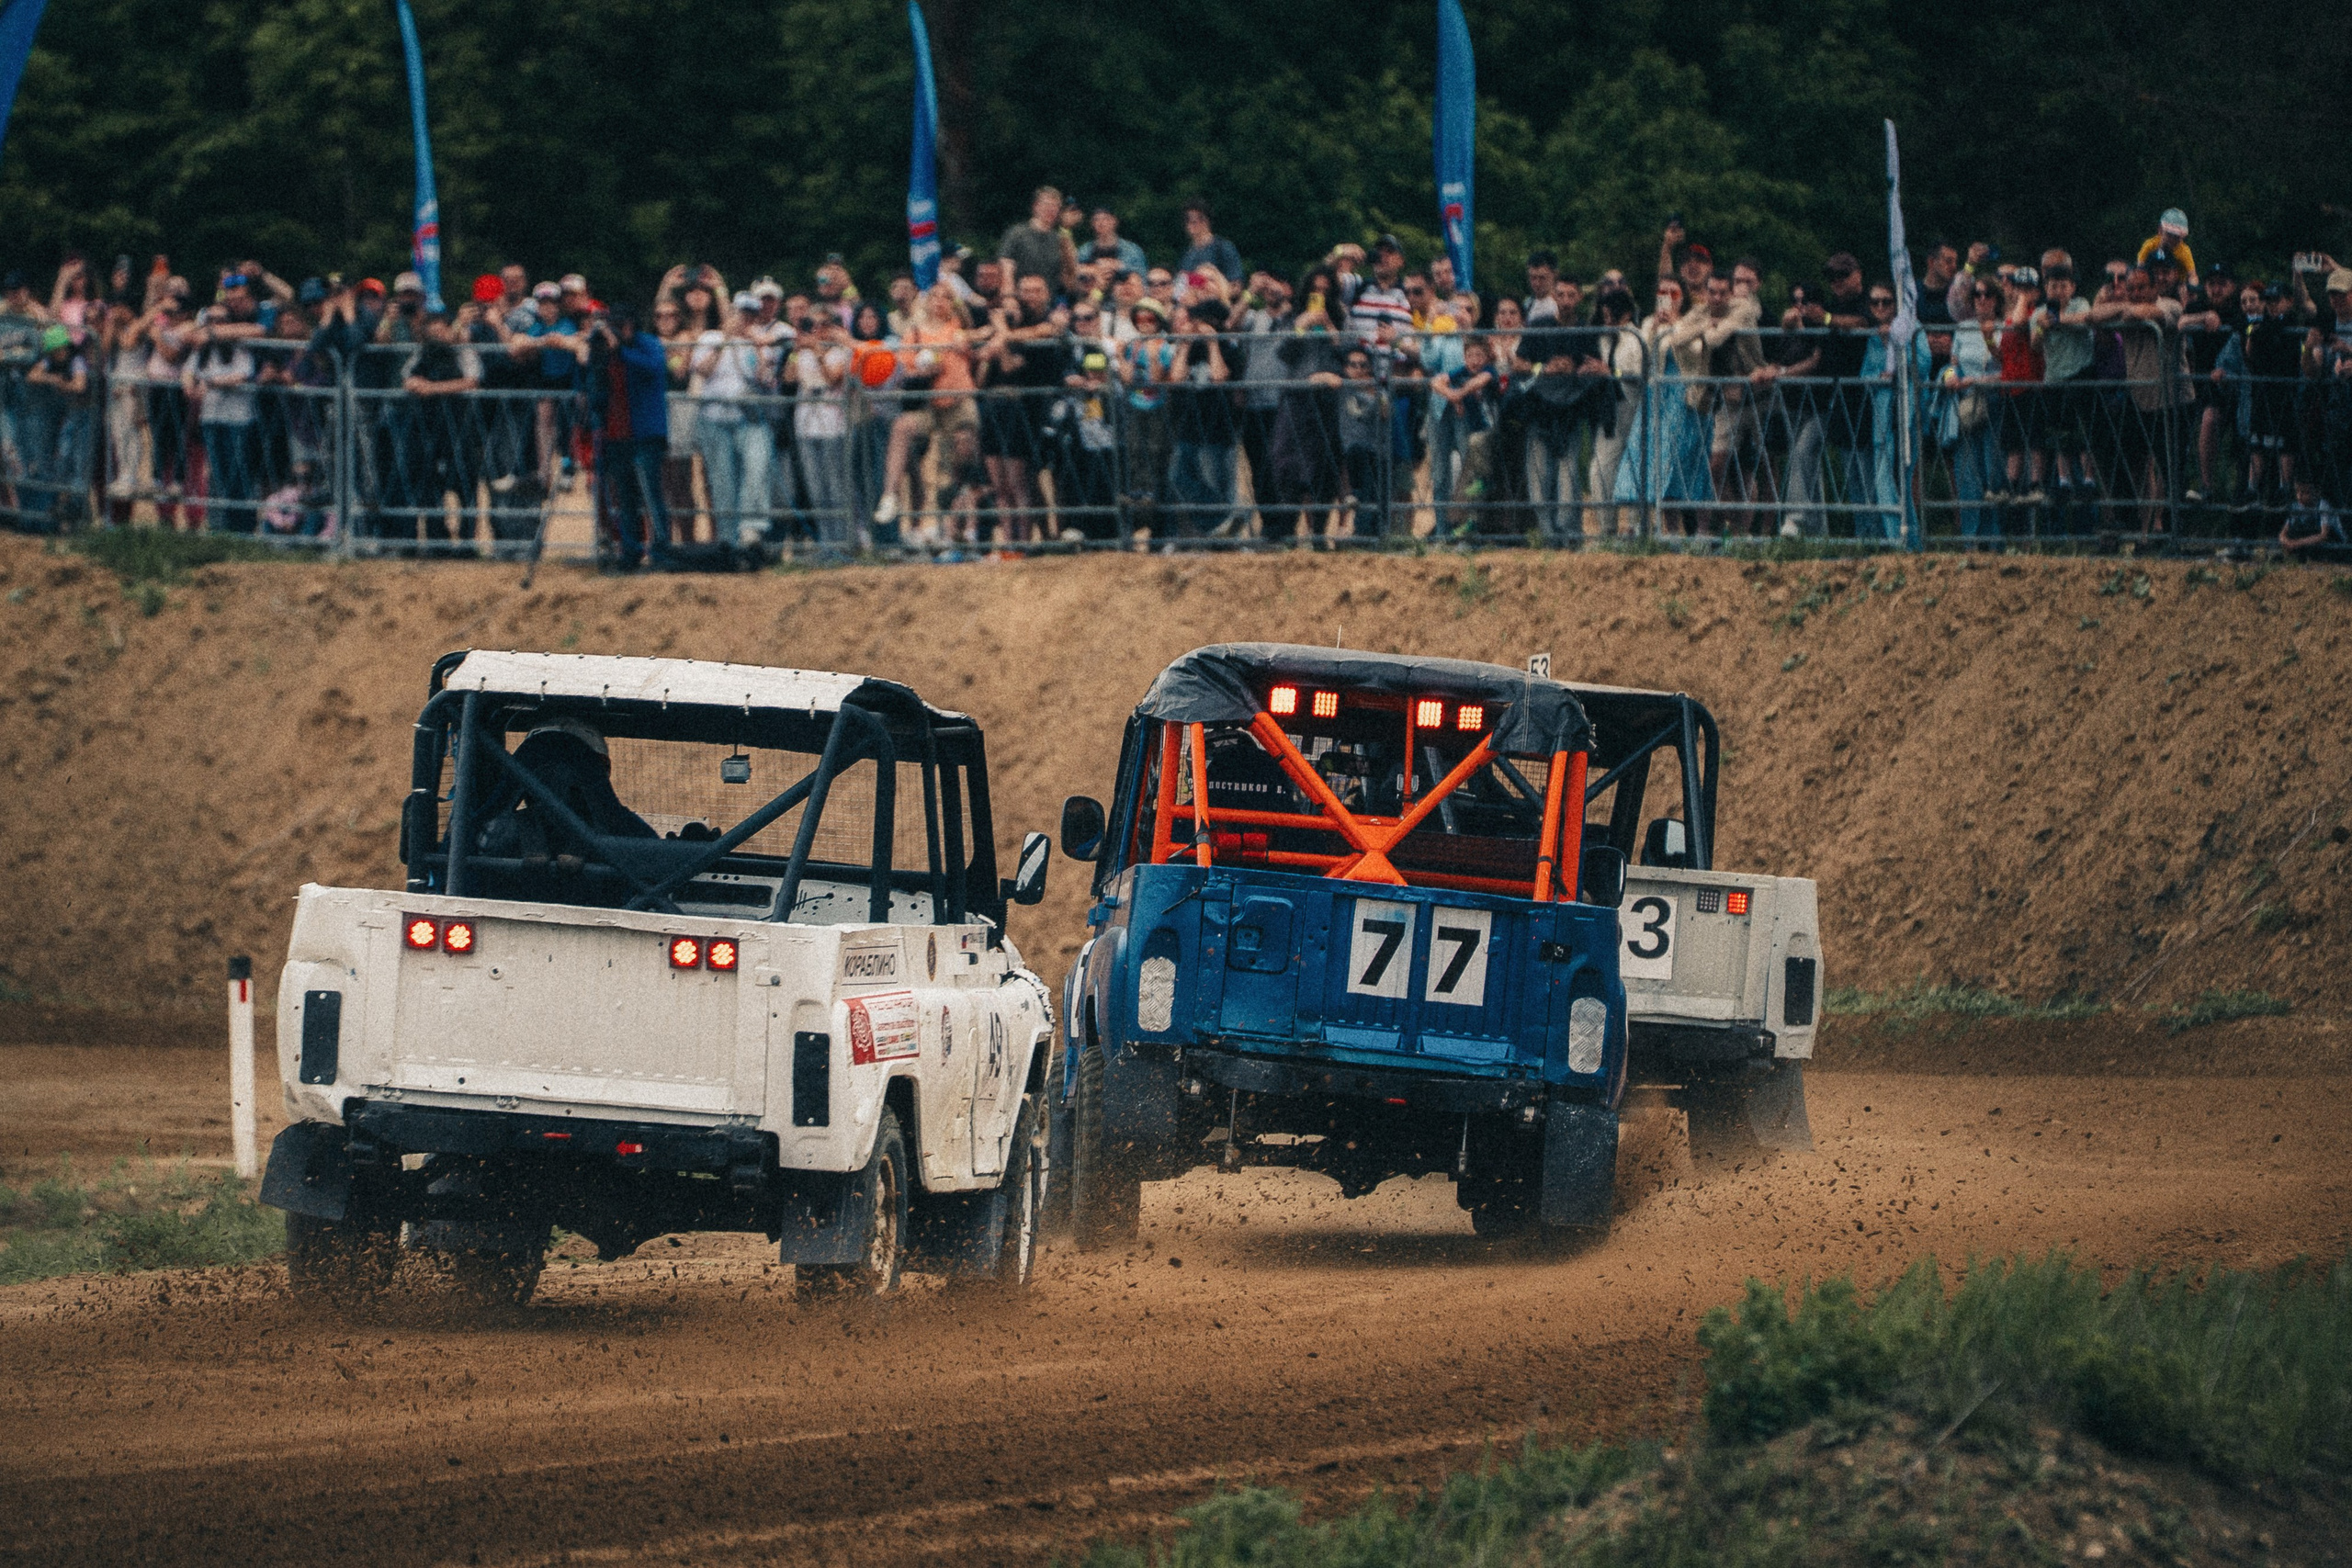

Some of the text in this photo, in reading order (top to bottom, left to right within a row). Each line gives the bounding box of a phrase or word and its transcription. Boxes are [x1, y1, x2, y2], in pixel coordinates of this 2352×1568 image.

[1208, 781, 1268, 793] ПОСТНИКОВ
[1359, 918, 1482, 994] 77
[1619, 897, 1671, 959] 3
